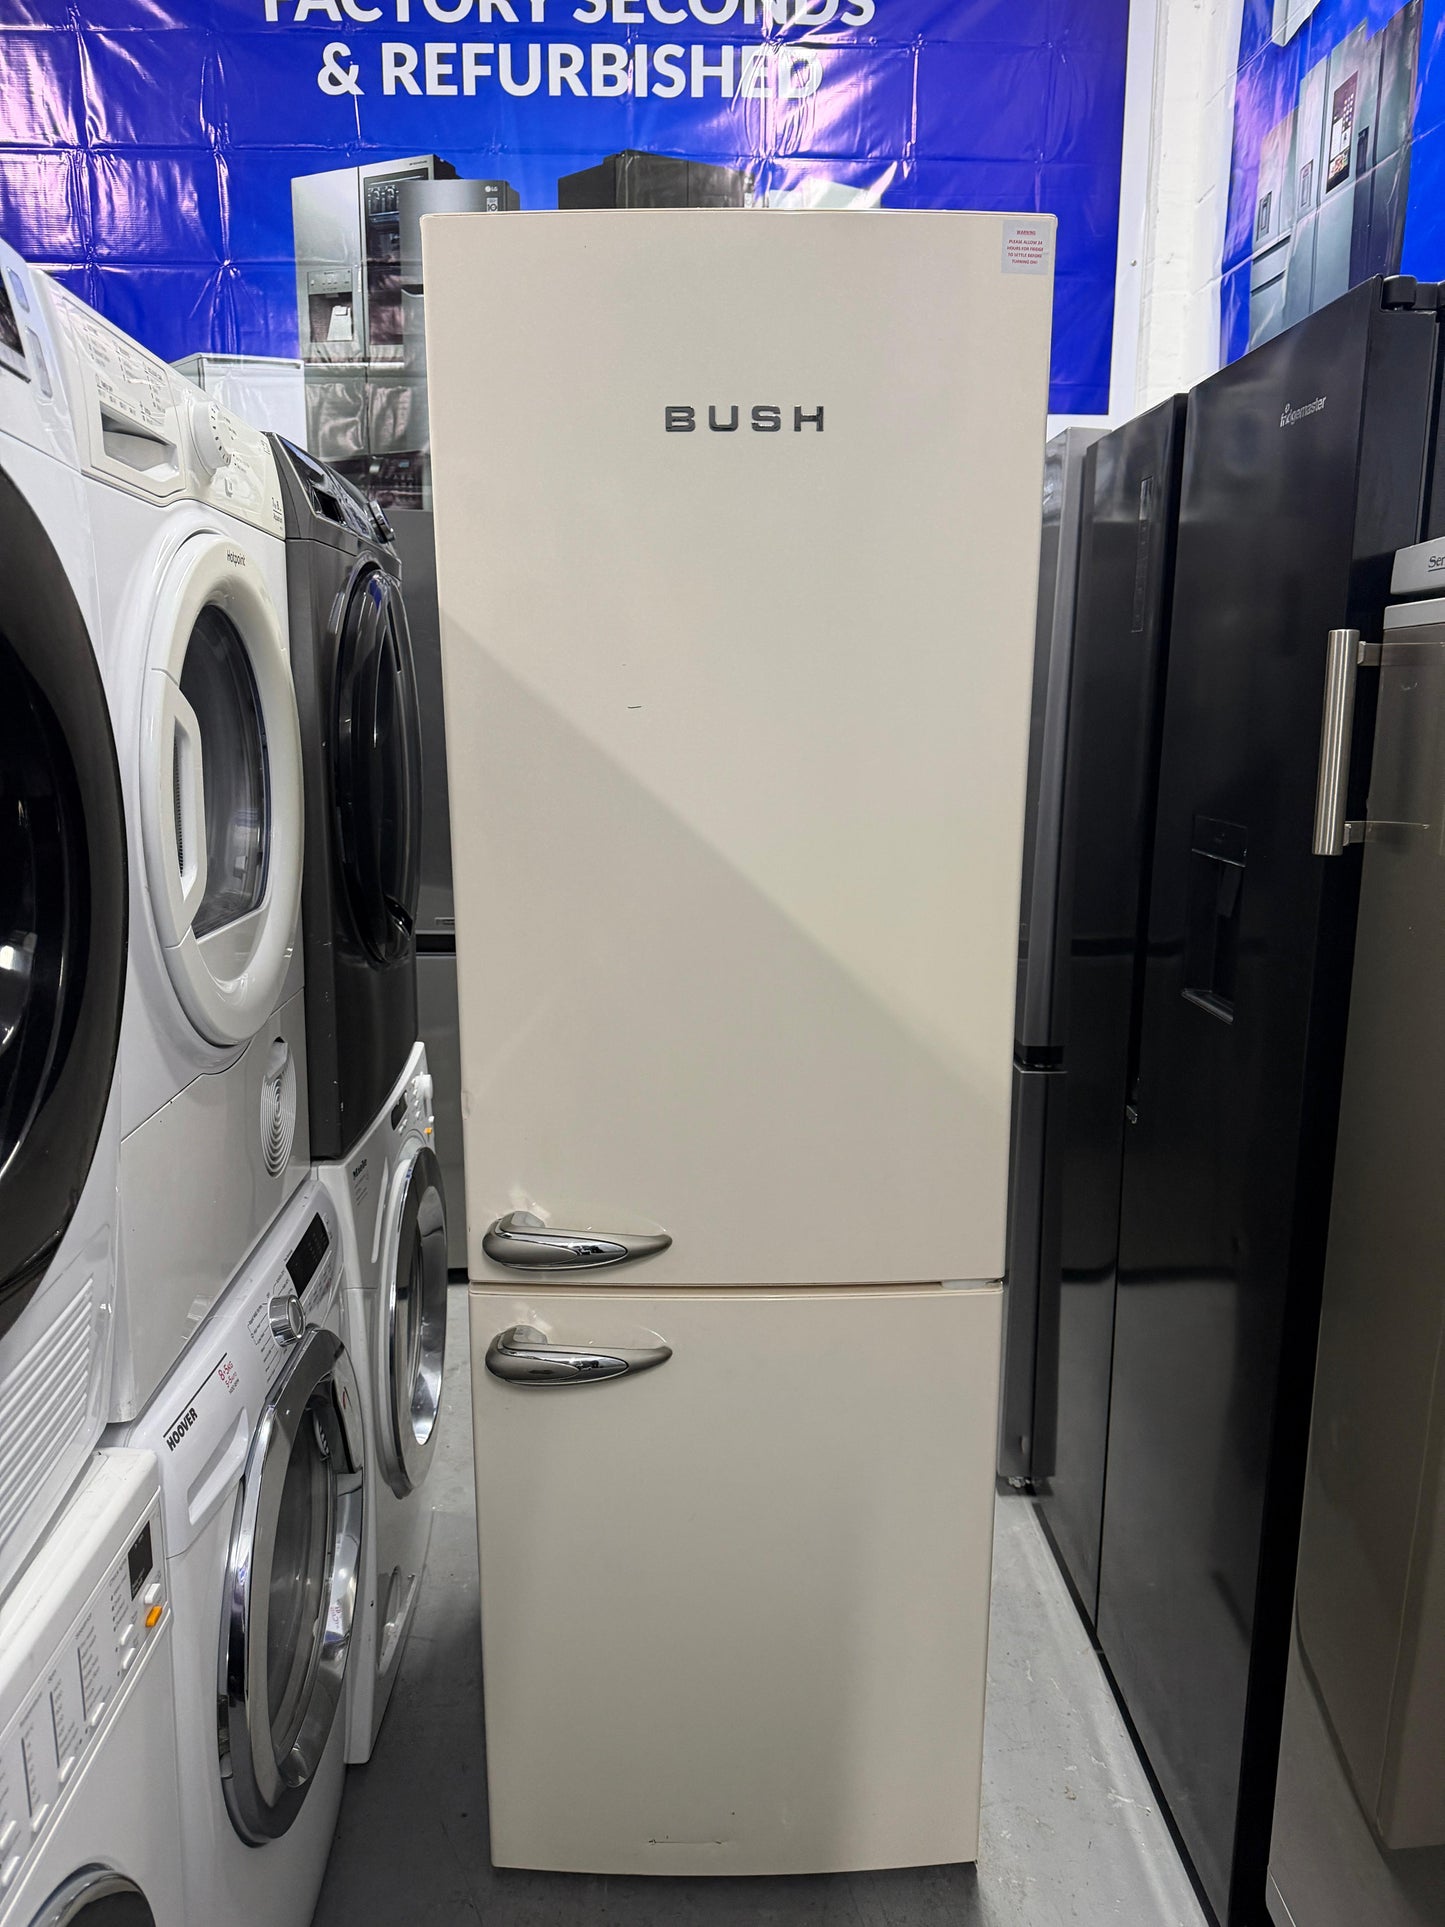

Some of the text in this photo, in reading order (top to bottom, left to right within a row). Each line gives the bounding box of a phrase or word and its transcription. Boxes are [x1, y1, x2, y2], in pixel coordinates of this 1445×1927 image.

[317, 42, 823, 98] & REFURBISHED
[665, 405, 824, 432] BUSH
[166, 1407, 198, 1452] HOOVER
